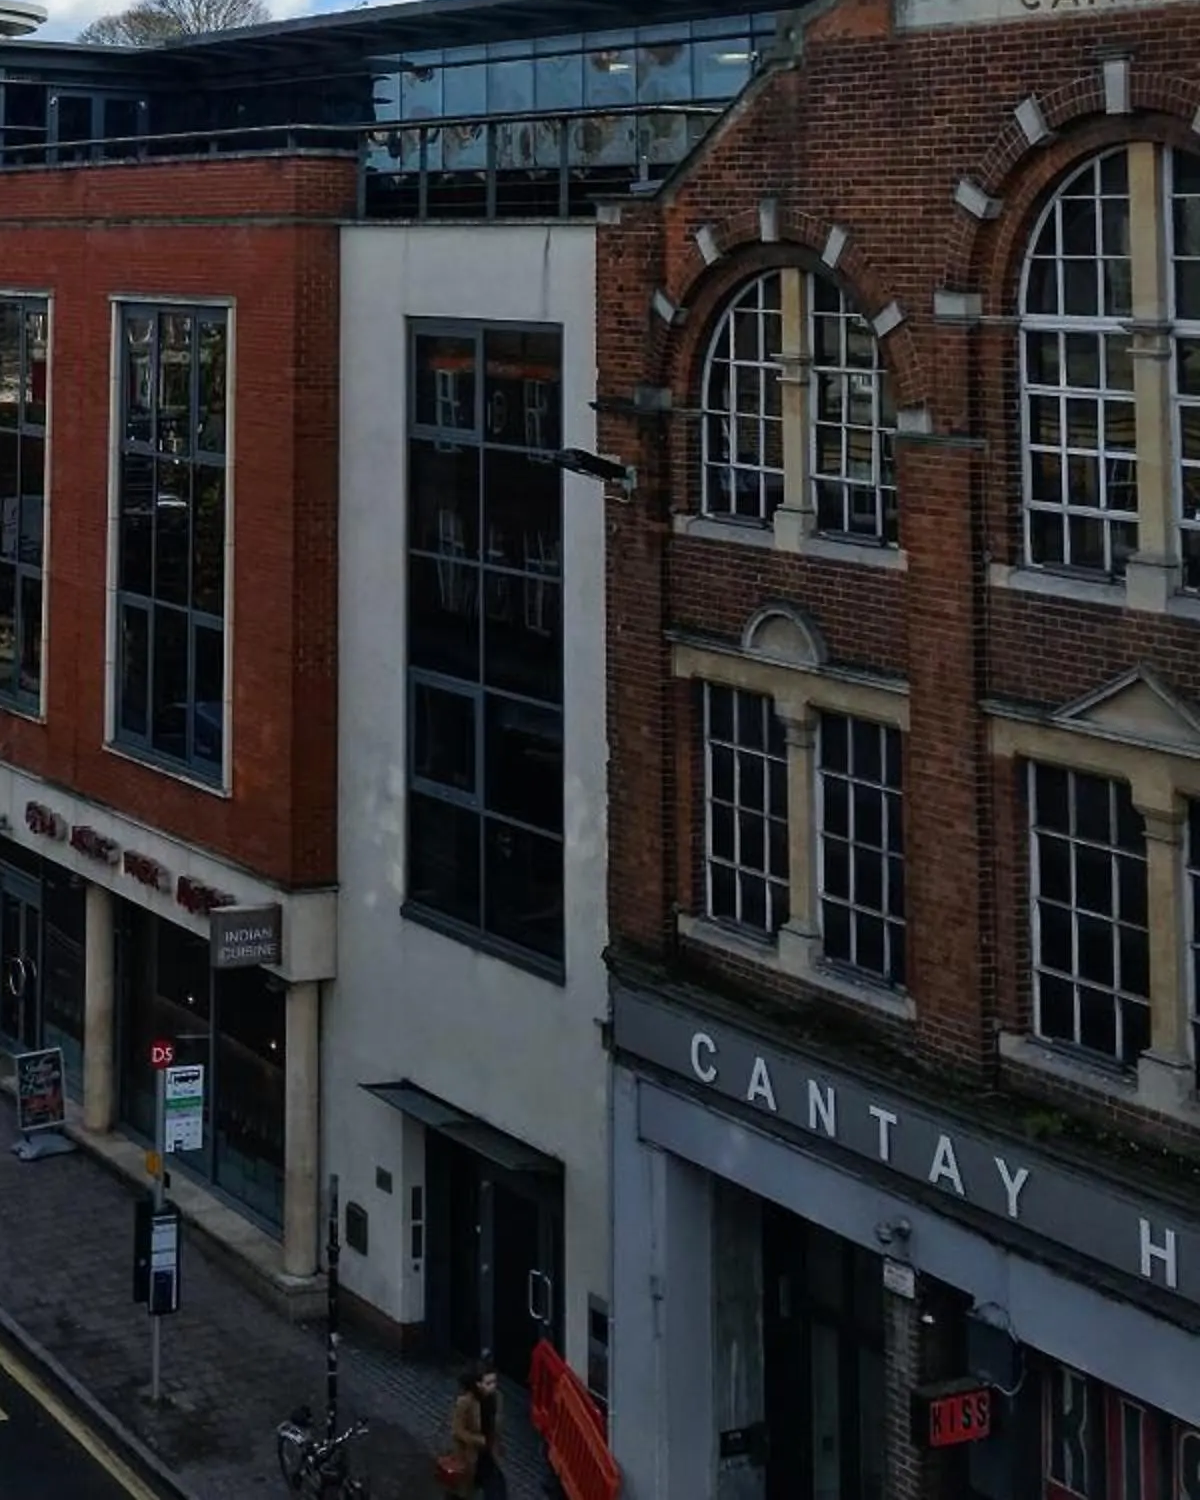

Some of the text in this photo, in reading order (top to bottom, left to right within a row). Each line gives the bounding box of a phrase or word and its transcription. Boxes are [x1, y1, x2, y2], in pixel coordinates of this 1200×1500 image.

[225, 927, 273, 943] INDIAN
[220, 944, 277, 961] CUISINE
[151, 1046, 173, 1063] D5
[691, 1032, 1030, 1219] CANTAY
[932, 1396, 988, 1438] KISS
